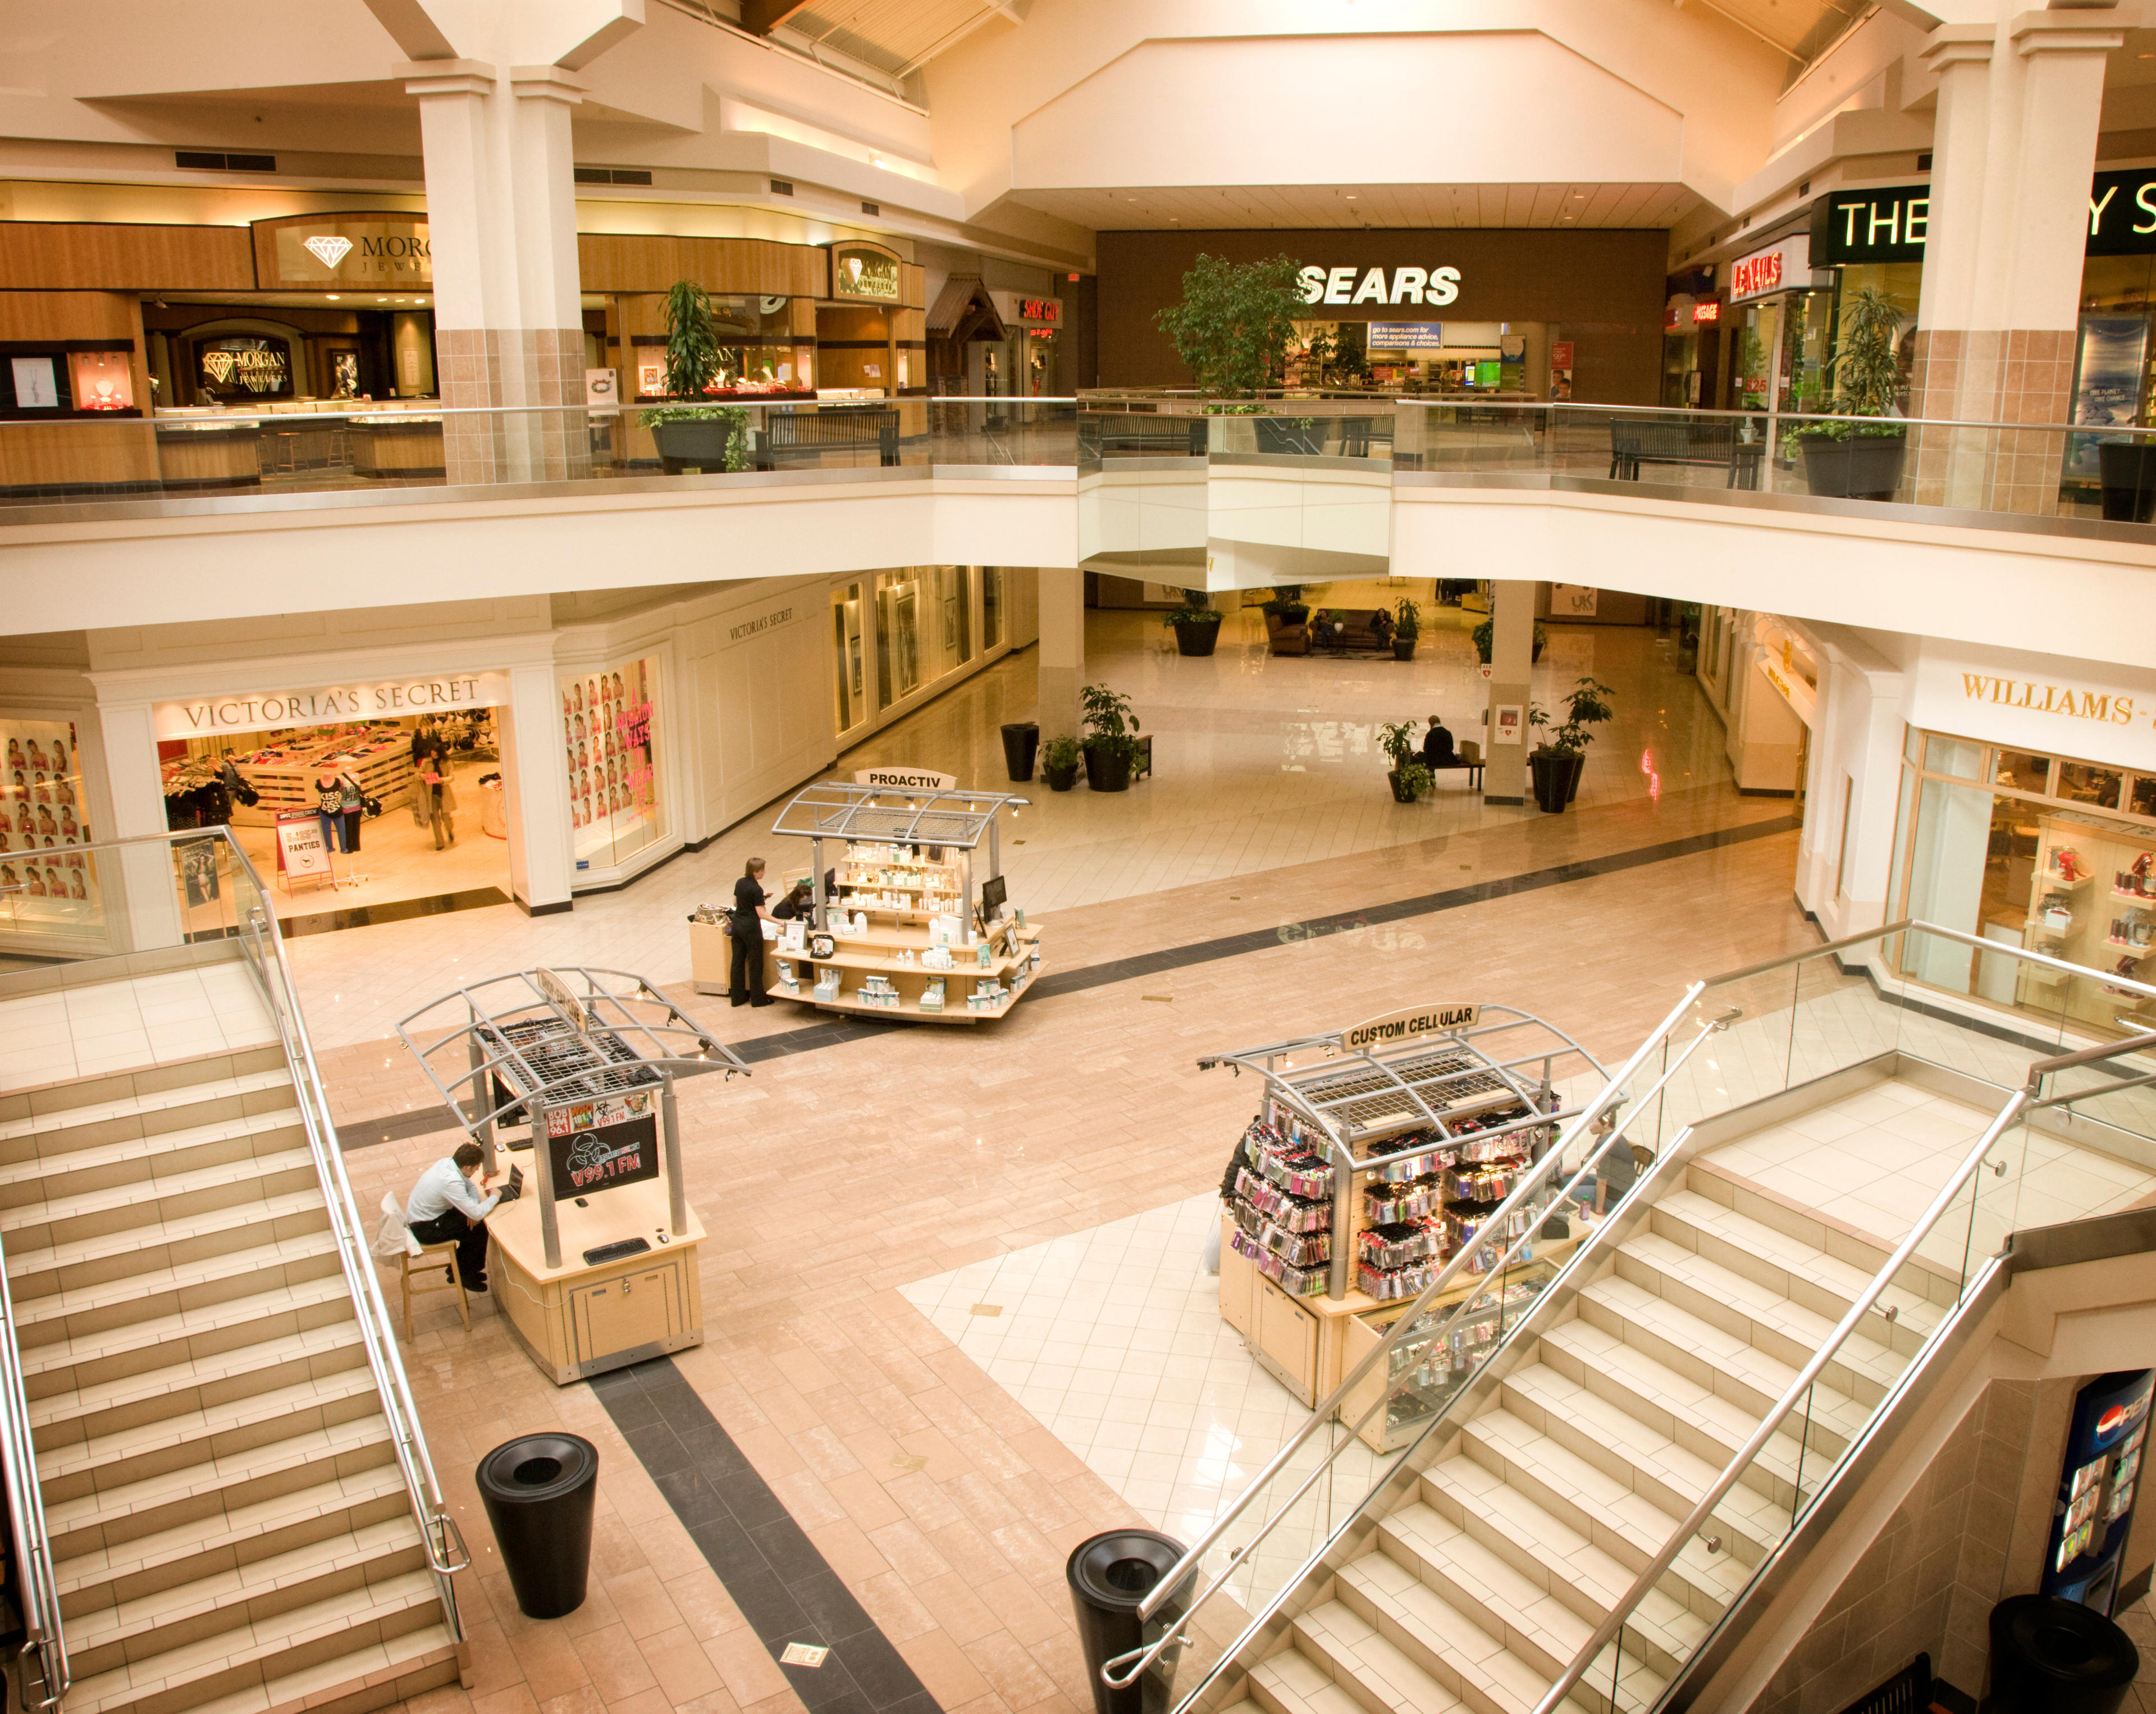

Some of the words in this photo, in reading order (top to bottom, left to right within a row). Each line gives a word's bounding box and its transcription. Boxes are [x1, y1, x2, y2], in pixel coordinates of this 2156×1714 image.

[1837, 198, 1929, 246] THE
[362, 262, 422, 273] JEWE
[861, 260, 892, 282] MORGAN
[1733, 266, 1747, 295] LE
[1747, 252, 1780, 290] NAILS
[1296, 266, 1461, 306] SEARS
[1025, 299, 1043, 319] SHOE
[1045, 301, 1058, 321] GUY
[1693, 304, 1718, 321] MASSAGE
[236, 351, 286, 367] MORGAN
[239, 374, 288, 385] JEWELERS
[1746, 378, 1767, 392] $25
[730, 616, 768, 641] VICTORIA'S
[770, 607, 792, 627] SECRET
[184, 691, 360, 729] VICTORIA'S
[375, 679, 479, 710] SECRET
[1962, 672, 2134, 725] WILLIAMS
[615, 700, 654, 733] MILLION
[624, 723, 650, 750] WAYS
[626, 763, 654, 791] WEAR
[870, 773, 941, 788] PROACTIV
[320, 790, 339, 801] KISS
[288, 840, 320, 853] PANTIES
[1351, 1020, 1405, 1045] CUSTOM
[1409, 1007, 1473, 1033] CELLULAR
[547, 1108, 568, 1120] BOB
[549, 1117, 568, 1127] FM
[573, 1110, 593, 1125] 101.1
[597, 1114, 615, 1127] V99.1
[615, 1111, 625, 1122] FM
[550, 1123, 569, 1136] 96.1
[570, 1160, 615, 1187] V99.1
[618, 1153, 642, 1174] FM
